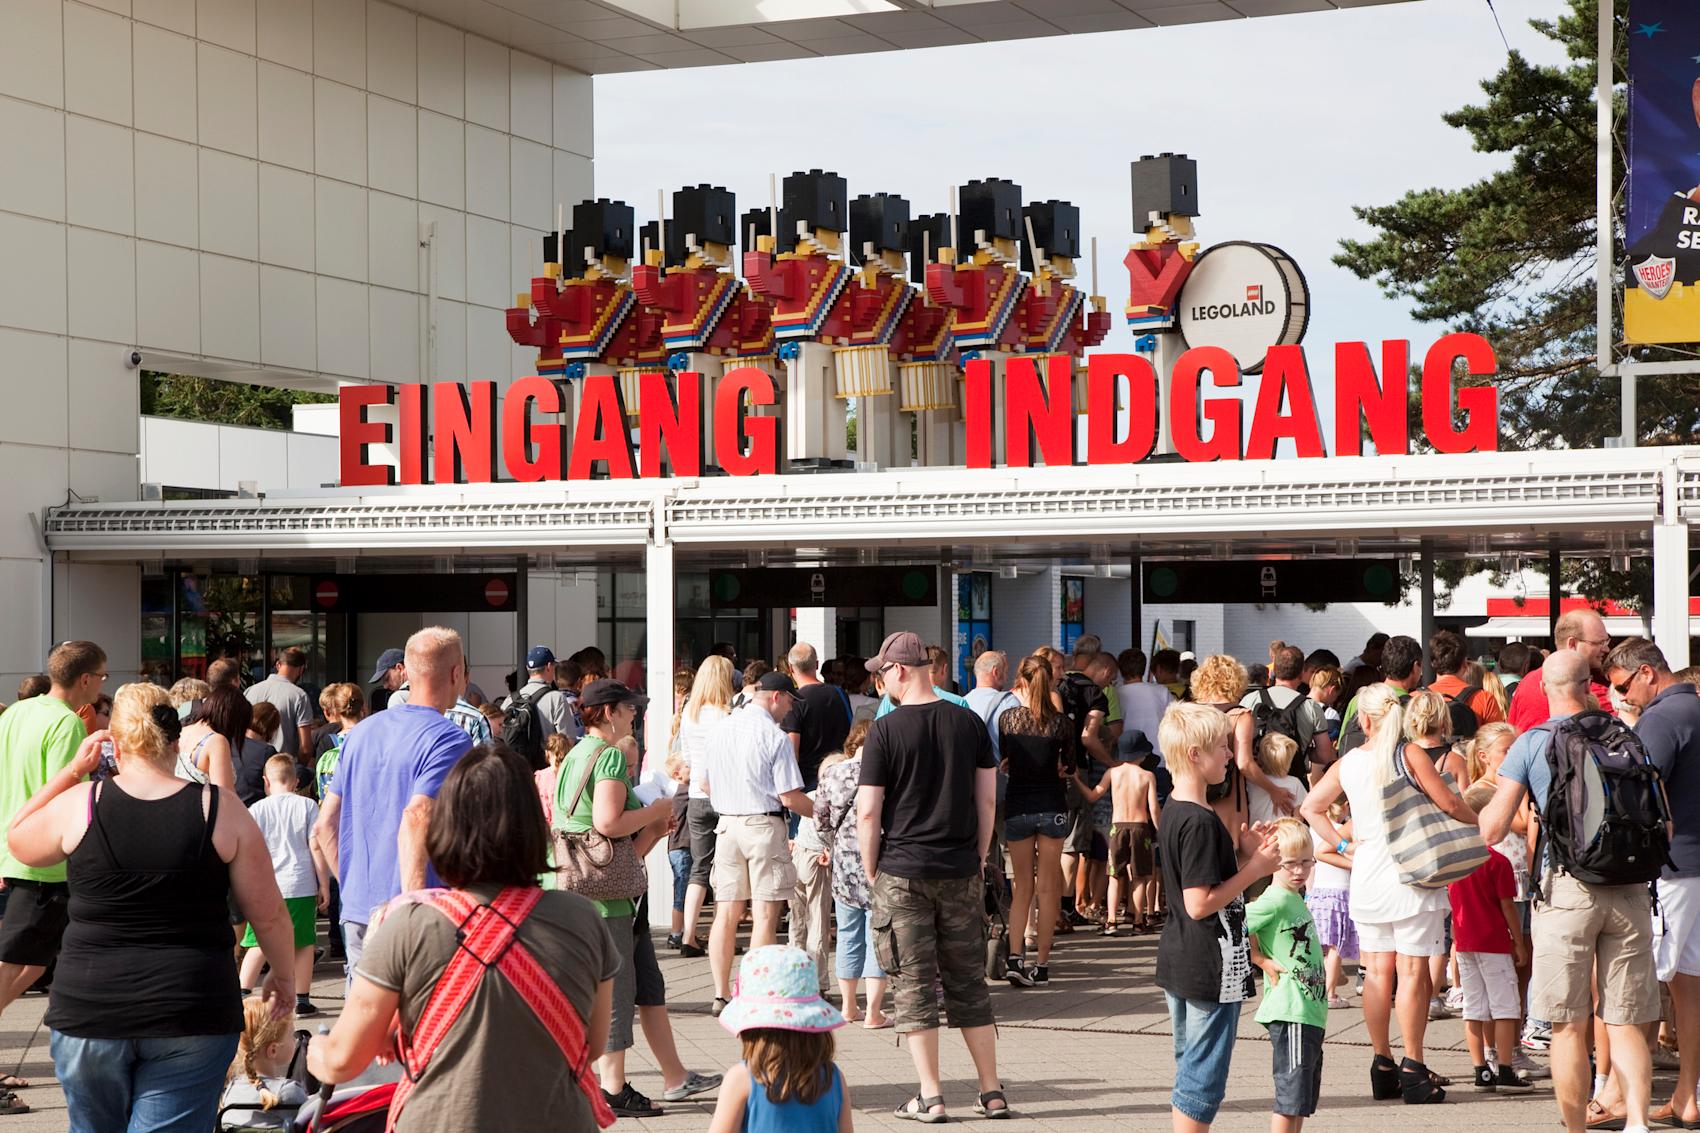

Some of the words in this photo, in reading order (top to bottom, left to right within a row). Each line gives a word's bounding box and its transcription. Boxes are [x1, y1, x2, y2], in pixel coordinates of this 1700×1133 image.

[1683, 206, 1700, 225] R
[1639, 263, 1671, 281] HEROES
[1192, 299, 1275, 321] LEGOLAND
[340, 367, 779, 486] EINGANG
[966, 332, 1497, 469] INDGANG
